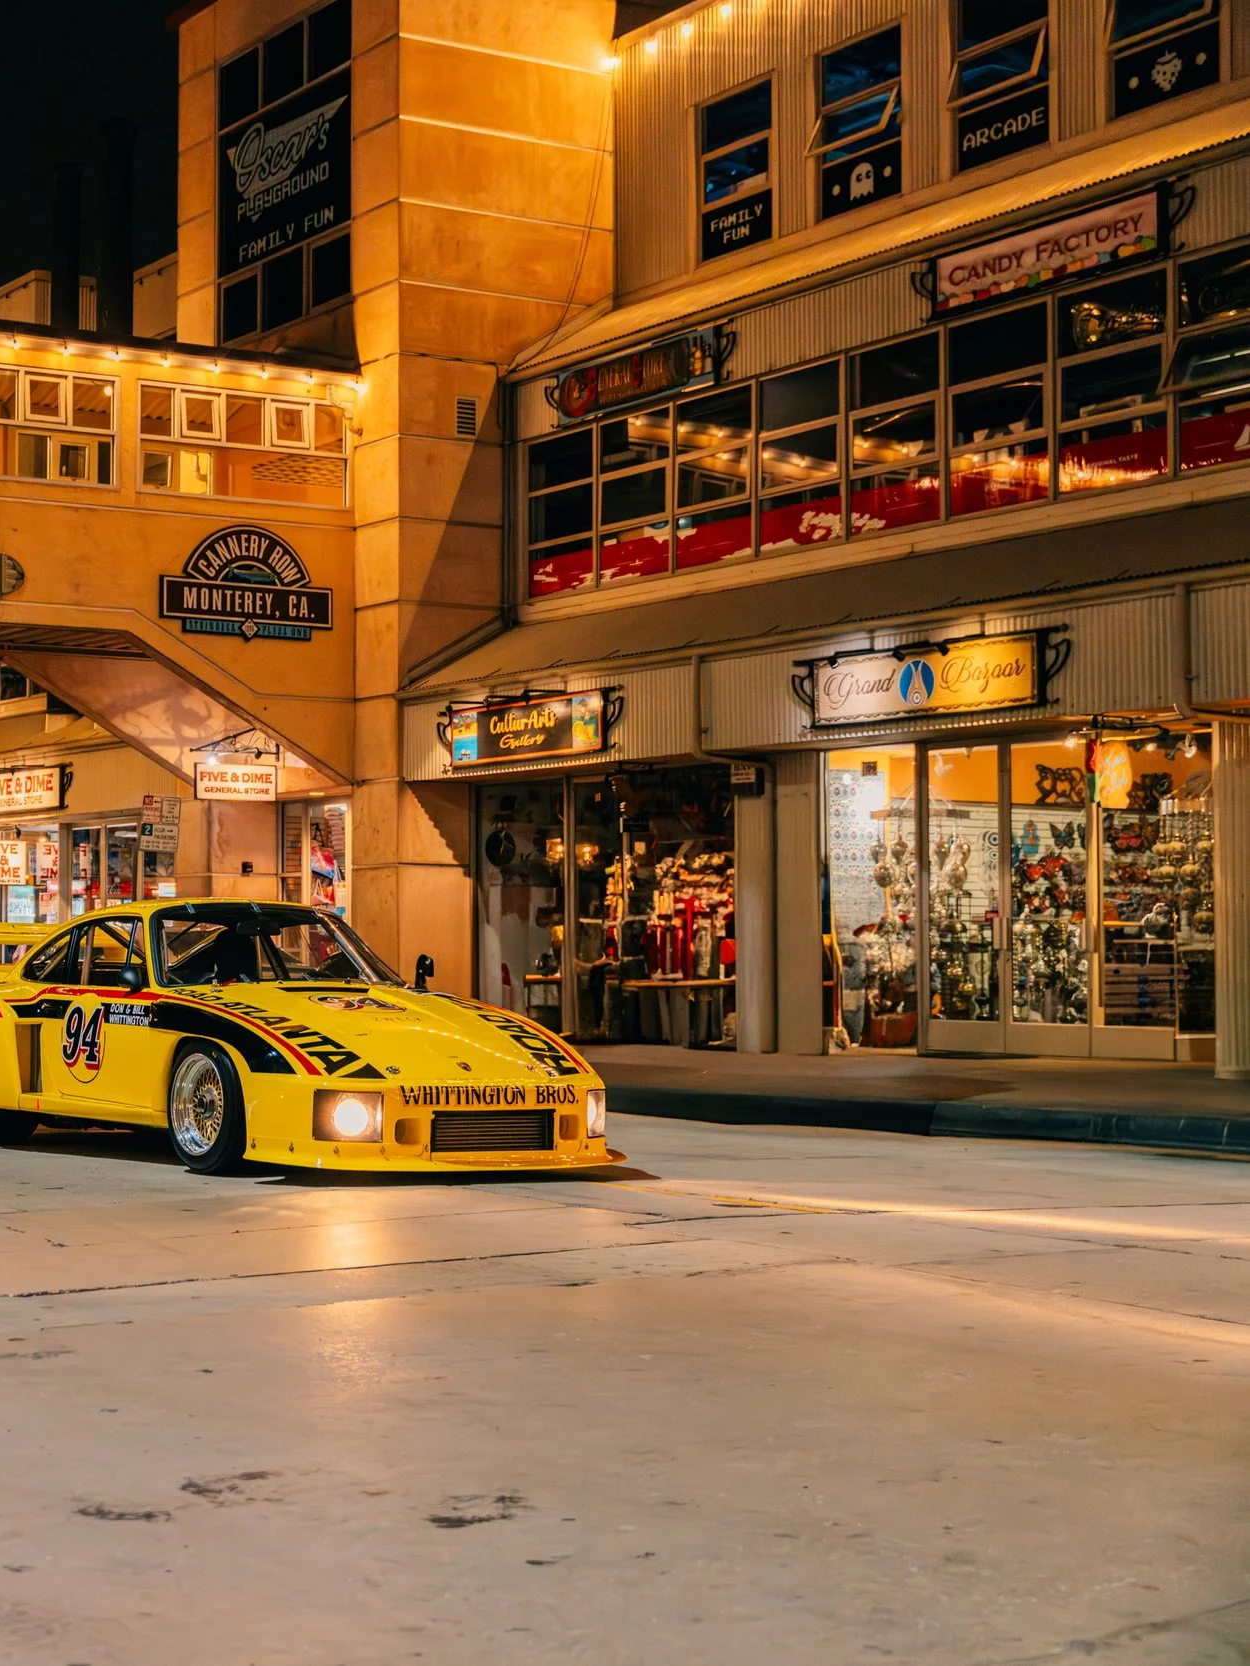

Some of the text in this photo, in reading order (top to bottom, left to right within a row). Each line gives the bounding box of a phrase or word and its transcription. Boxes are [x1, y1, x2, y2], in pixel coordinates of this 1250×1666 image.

[963, 106, 1046, 151] ARCADE
[235, 113, 330, 193] Oscar's
[238, 161, 329, 221] PLAYGROUND
[711, 203, 763, 233] FAMILY
[239, 205, 334, 263] FAMILY FUN
[723, 223, 750, 244] FUN
[949, 212, 1144, 287] CANDY FACTORY
[197, 534, 302, 584] CANNERY ROW
[183, 586, 316, 618] MONTEREY, CA.
[823, 655, 1027, 710] Grand Bazaar
[15, 780, 23, 794] &
[25, 772, 54, 794] DIME
[200, 771, 273, 784] FIVE & DIME
[204, 786, 270, 795] GENERAL STORE
[24, 794, 43, 806] STORE
[144, 824, 151, 835] 2
[0, 855, 10, 866] &
[109, 1014, 150, 1027] WHITTINGTON
[110, 1003, 145, 1015] DON & BILL
[62, 1004, 105, 1071] 94
[216, 1000, 362, 1076] ATLANTA
[400, 1084, 579, 1106] WHITTINGTON BROS.
